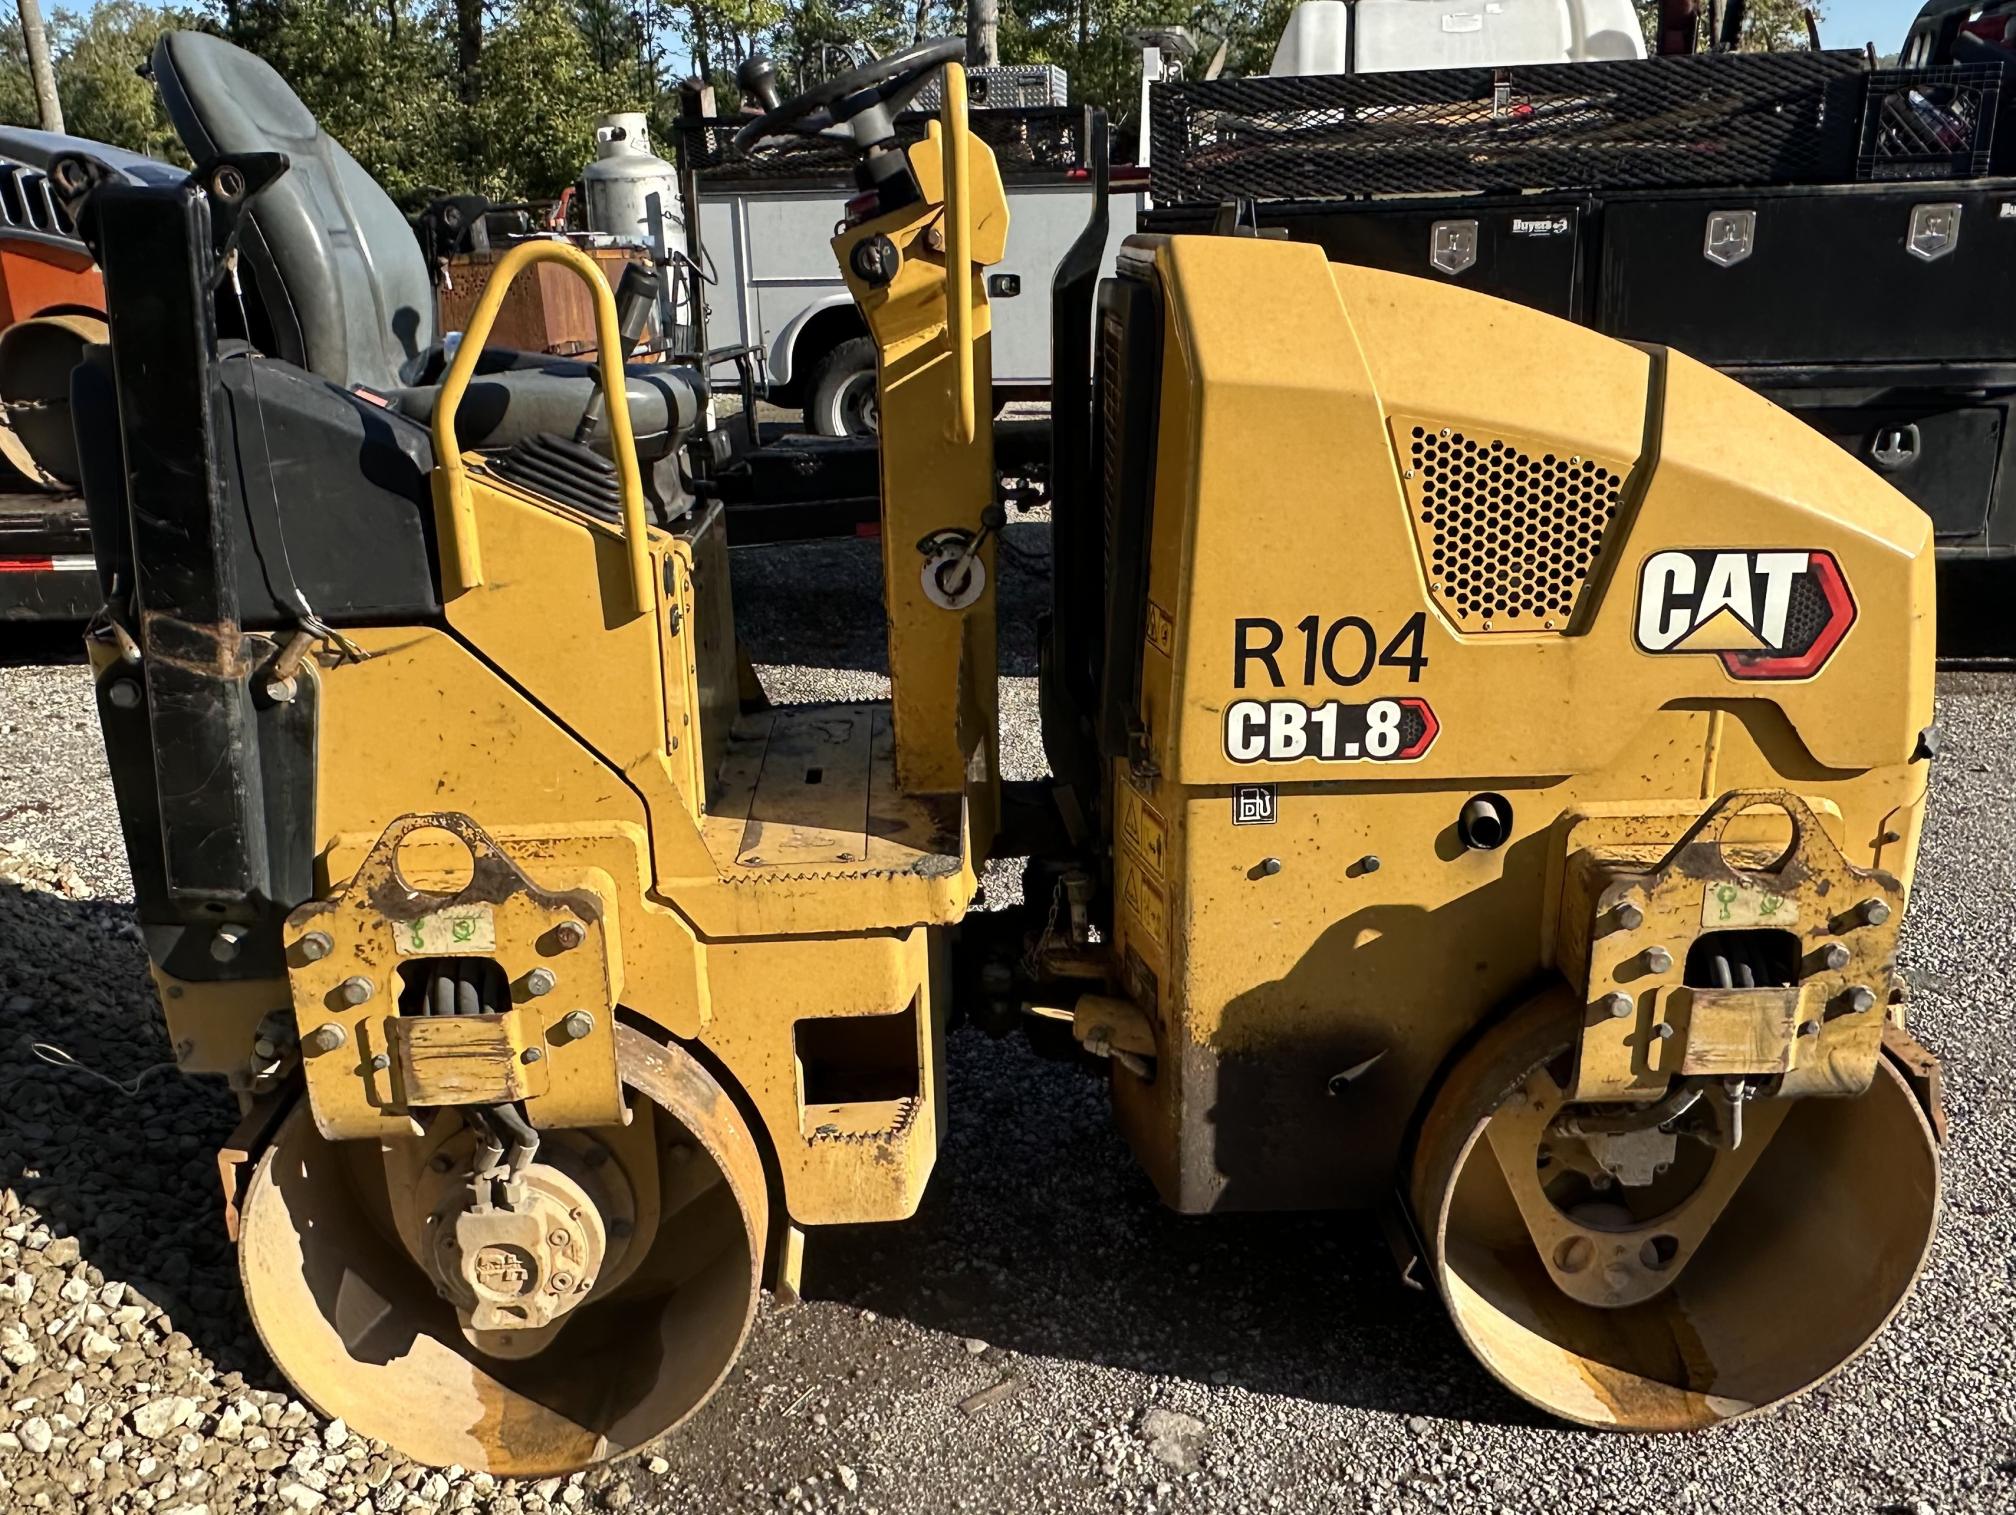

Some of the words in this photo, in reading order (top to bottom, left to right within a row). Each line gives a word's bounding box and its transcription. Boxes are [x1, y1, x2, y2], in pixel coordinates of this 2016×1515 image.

[1638, 552, 1810, 650] CAT
[1234, 612, 1428, 688] R104
[1228, 700, 1401, 758] CB1.8
[1245, 804, 1255, 815] D
